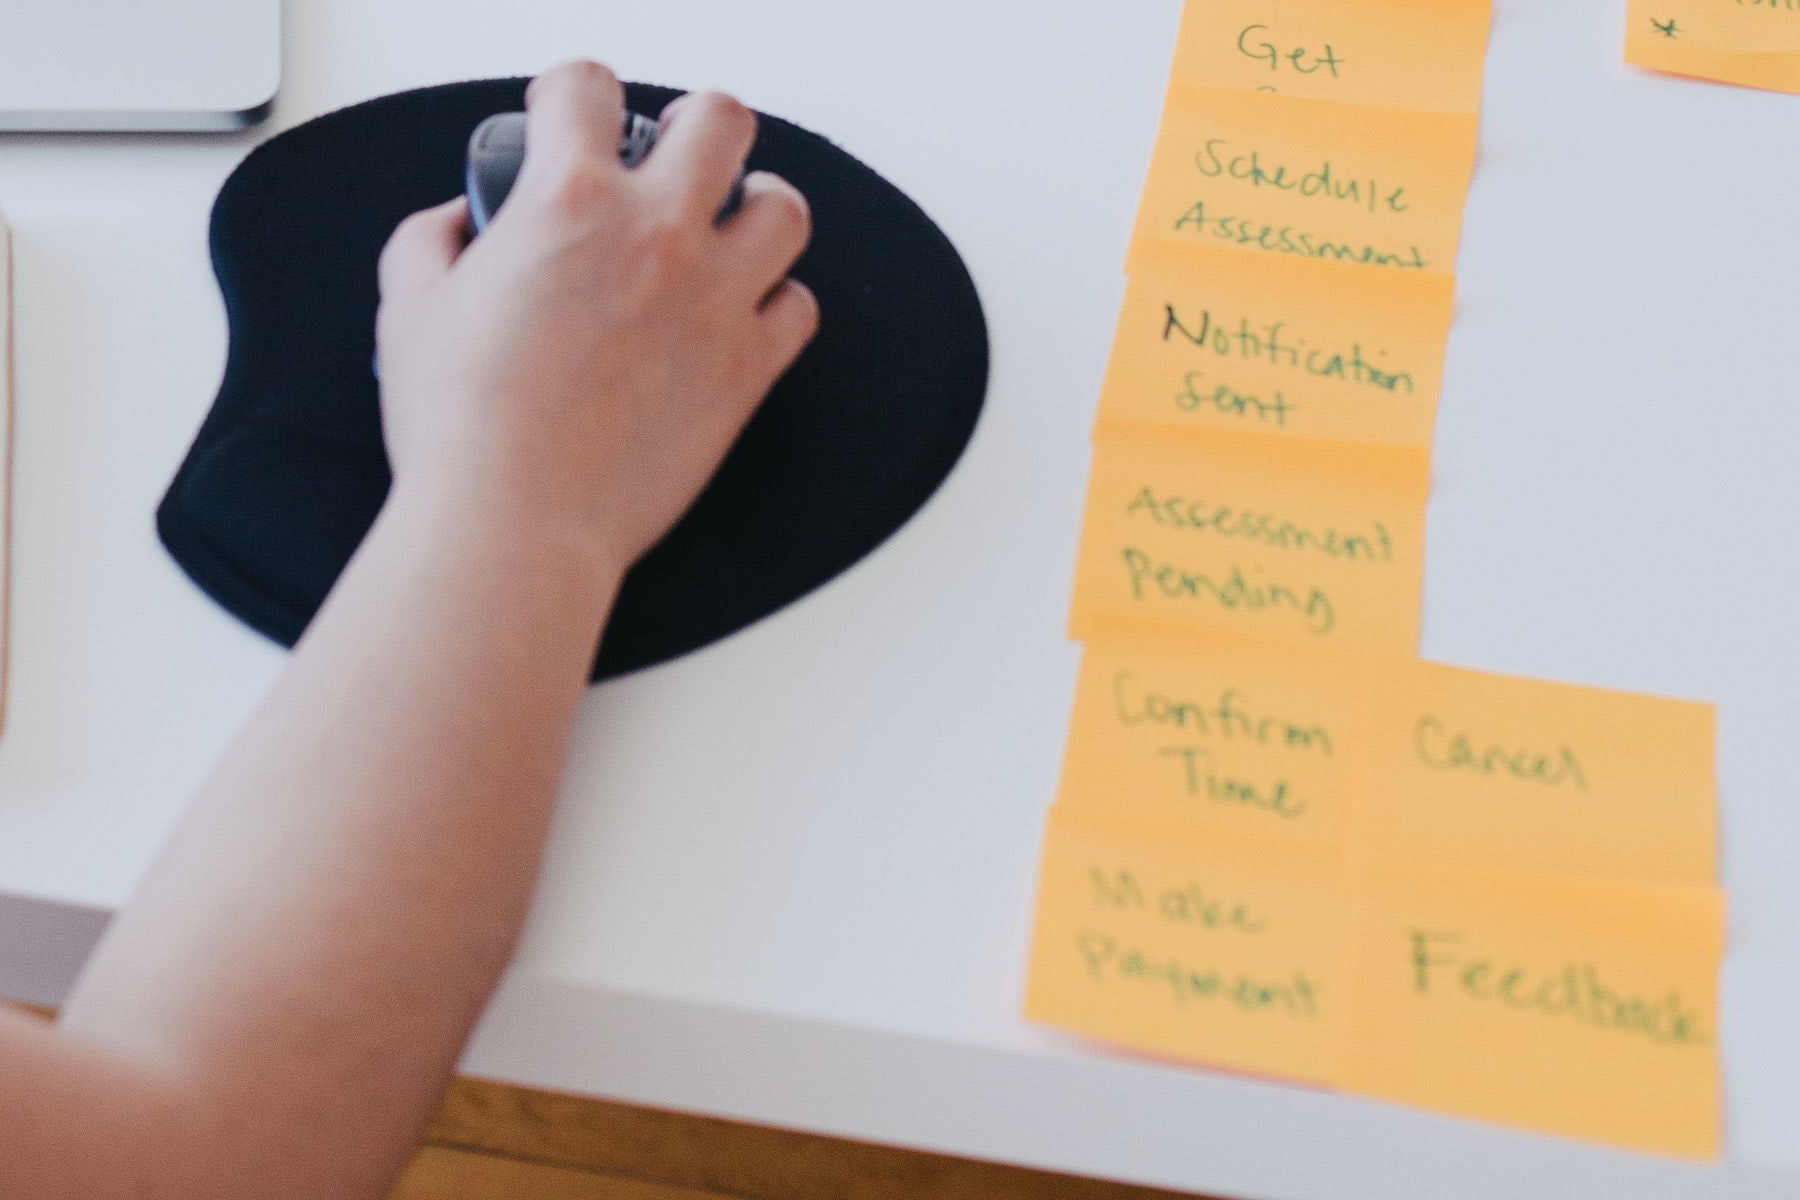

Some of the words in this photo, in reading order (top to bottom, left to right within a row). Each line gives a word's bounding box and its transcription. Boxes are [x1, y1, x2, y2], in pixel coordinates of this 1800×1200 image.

[1237, 24, 1345, 79] Get
[1195, 138, 1409, 213] Schedule
[1174, 201, 1429, 269] Assessment
[1162, 303, 1417, 395] Notification
[1126, 486, 1394, 562] Assessment
[1112, 669, 1332, 757] Confirm
[1158, 748, 1305, 818] Time
[1413, 715, 1589, 793] Cancel
